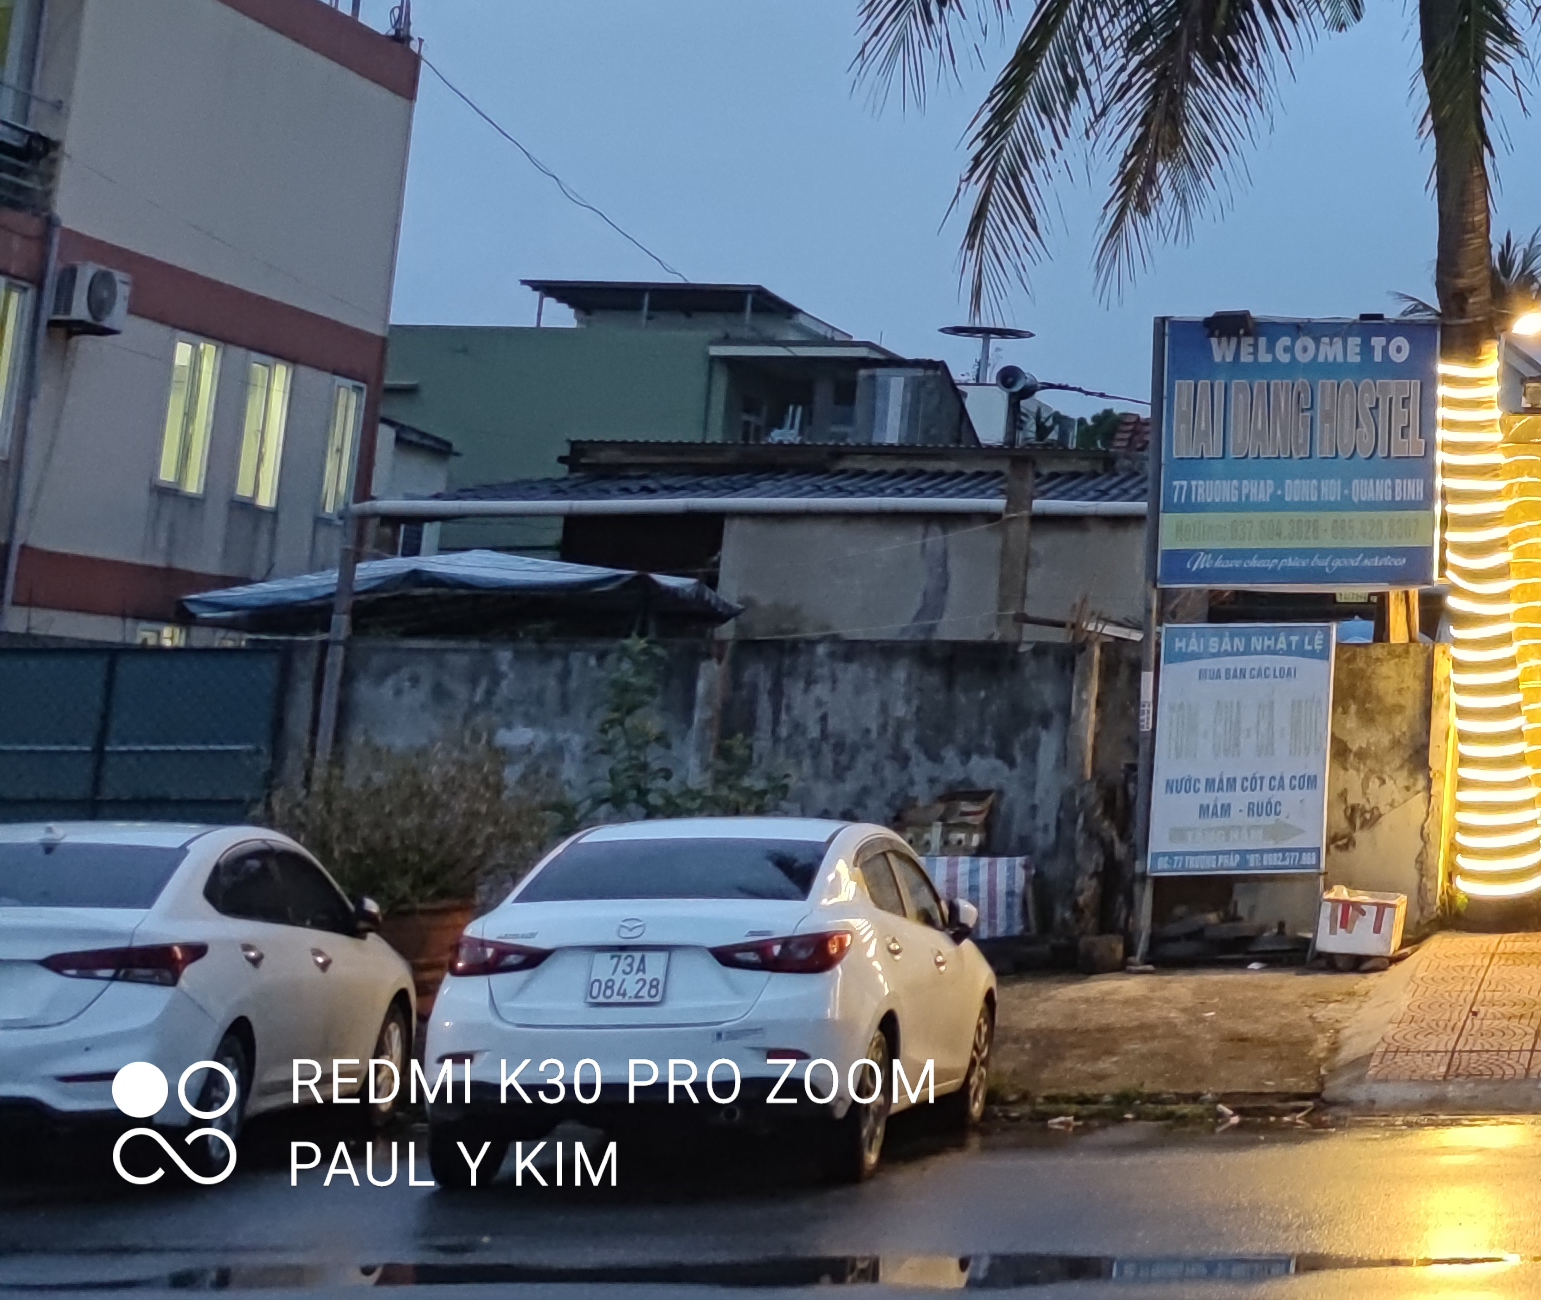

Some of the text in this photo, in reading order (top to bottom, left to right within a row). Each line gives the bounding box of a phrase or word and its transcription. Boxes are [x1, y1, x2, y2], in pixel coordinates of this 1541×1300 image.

[1210, 336, 1410, 363] WELCOME TO
[1173, 378, 1426, 459] HAI DANG HOSTEL
[1172, 481, 1187, 503] 77
[1191, 480, 1239, 502] TRUONG
[1242, 480, 1274, 502] PHAP
[1285, 479, 1317, 501] DONG
[1320, 479, 1341, 501] HOI
[1351, 479, 1392, 502] QUANG
[1395, 479, 1424, 501] BINH
[1187, 551, 1407, 573] We have cheap price but good services
[1251, 631, 1299, 654] NHẬT
[1304, 630, 1324, 653] LỆ
[1165, 774, 1201, 794] NƯỚC
[1240, 771, 1265, 792] CỐT
[1289, 773, 1318, 791] CƠM
[1247, 796, 1282, 818] RUỐC
[610, 953, 646, 976] 73A
[589, 977, 660, 1000] 084.28
